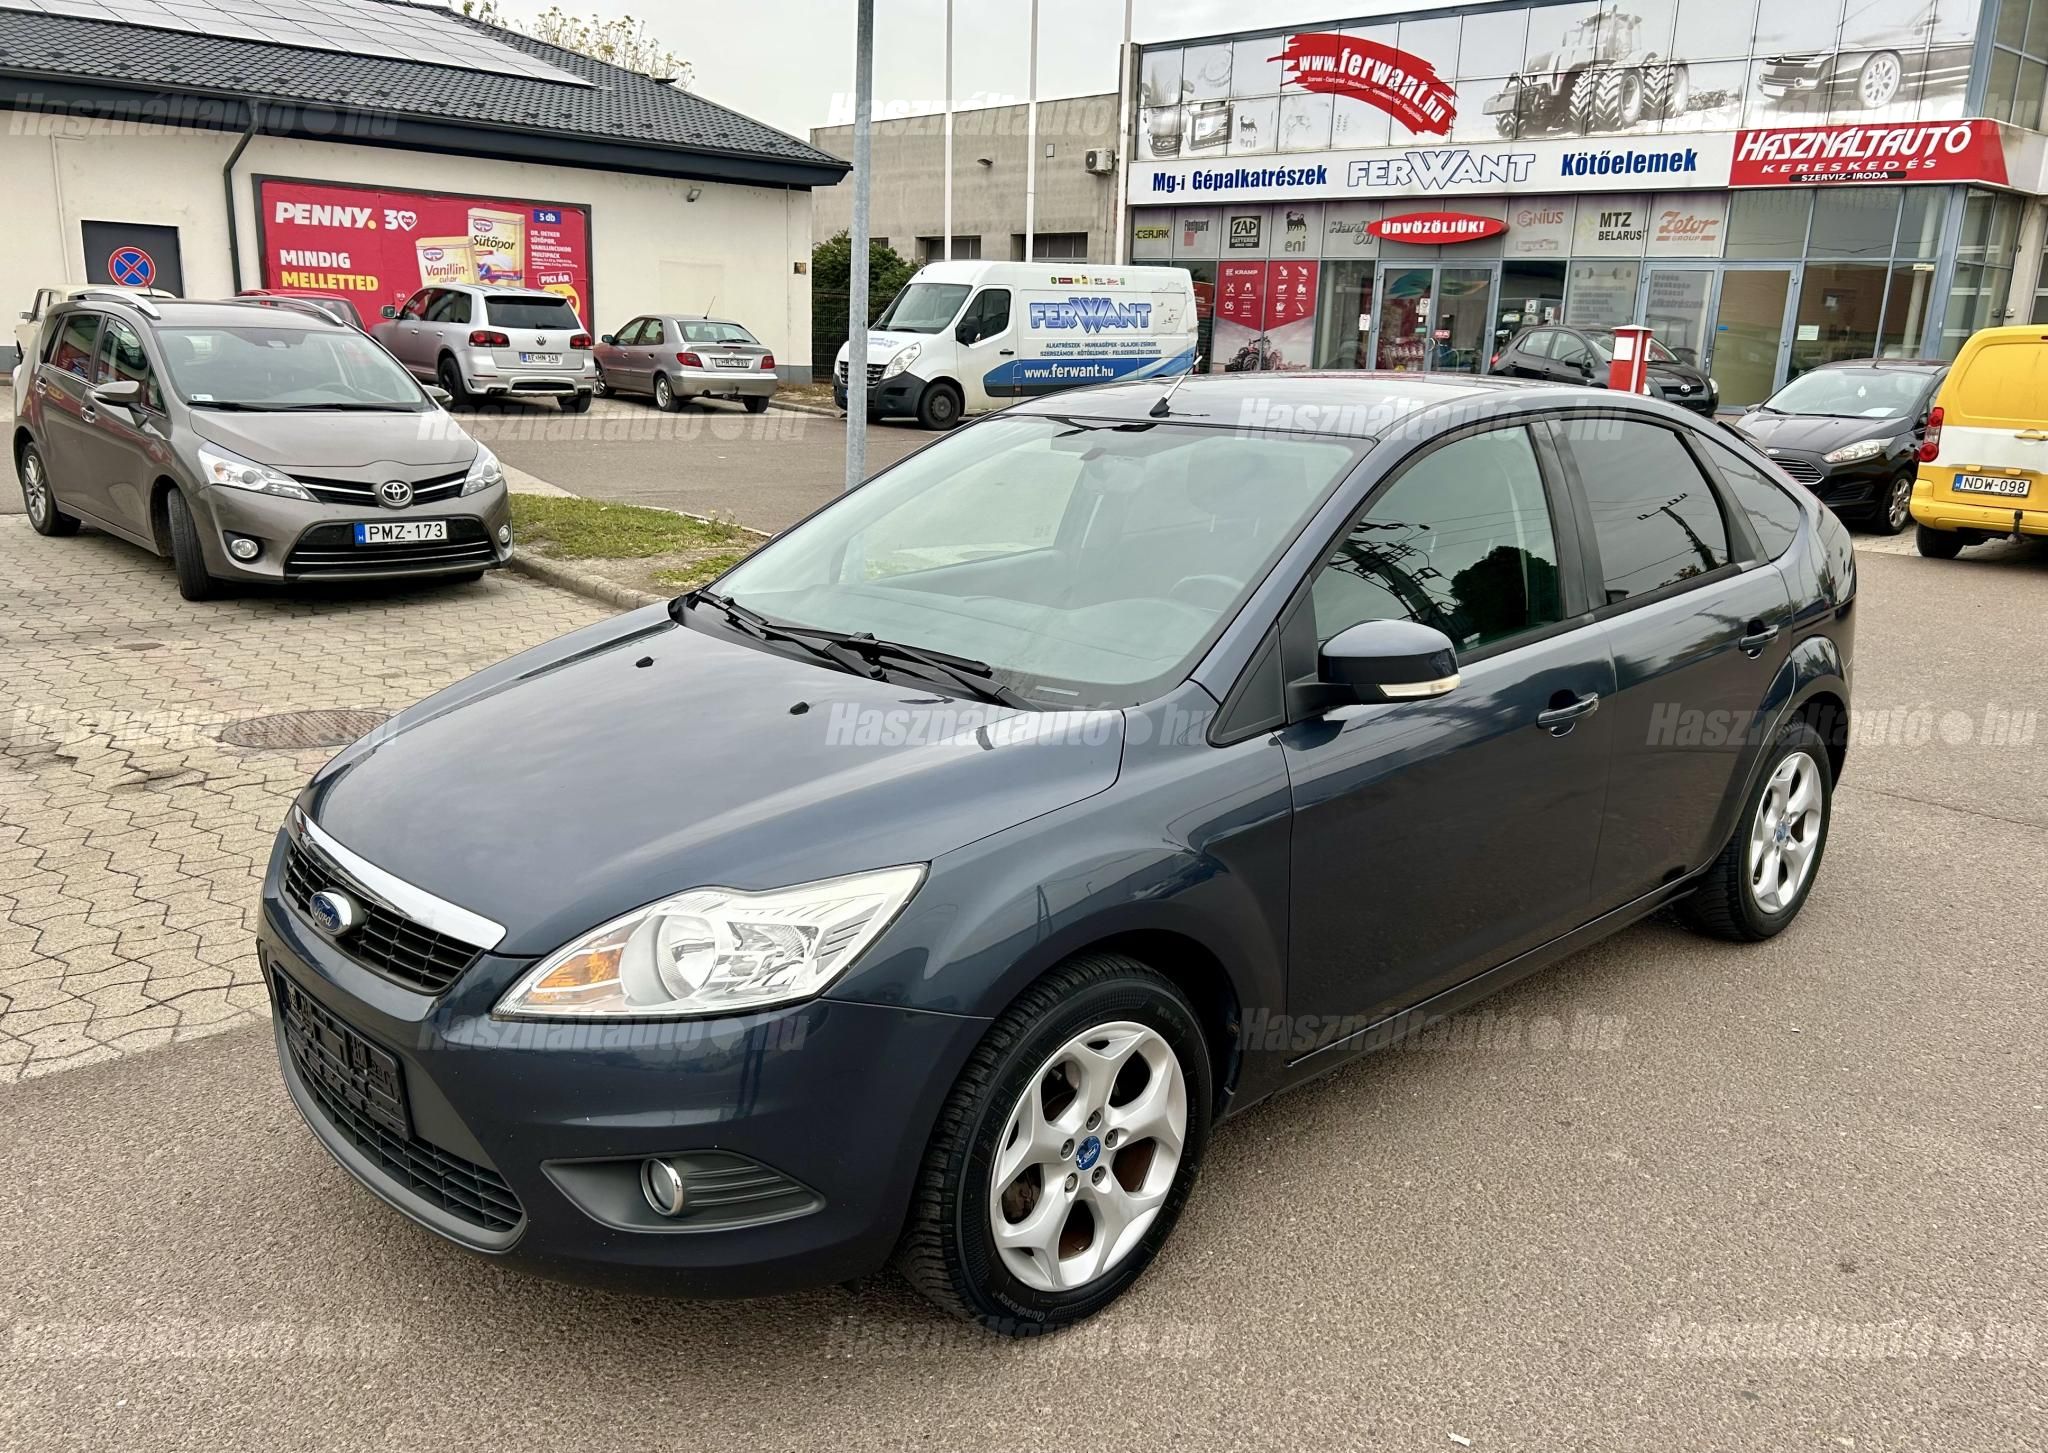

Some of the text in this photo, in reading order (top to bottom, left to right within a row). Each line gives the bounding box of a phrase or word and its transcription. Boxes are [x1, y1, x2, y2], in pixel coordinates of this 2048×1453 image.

[1299, 47, 1447, 124] www.ferwant.hu
[1736, 121, 1972, 162] HASZNÁLTAUTÓ
[1347, 150, 1536, 190] FERWANT
[1561, 148, 1698, 177] Kötőelemek
[1761, 158, 1937, 174] KERESKEDÉS
[1152, 164, 1327, 194] Mg-i Gépalkatrészek
[1801, 171, 1889, 182] SZERVIZ-IRODA
[539, 213, 556, 222] 5 db
[1599, 211, 1632, 228] MTZ
[1659, 210, 1720, 235] Zetor
[1233, 220, 1256, 234] ZAP
[1380, 220, 1485, 236] ÜDVÖZÖLJÜK!
[1598, 230, 1642, 241] BELARUS
[473, 234, 515, 252] Sütőpor
[1285, 236, 1306, 252] eni
[280, 249, 351, 269] MINDIG
[425, 263, 469, 276] Vanillin-
[540, 272, 570, 284] PICI ÁR
[281, 271, 379, 291] MELLETTED
[1029, 297, 1151, 334] FERWANT
[1024, 363, 1114, 378] www.ferwant.hu
[1964, 477, 2026, 493] NDW-098
[368, 523, 443, 541] PMZ-173
[313, 899, 335, 927] Ford
